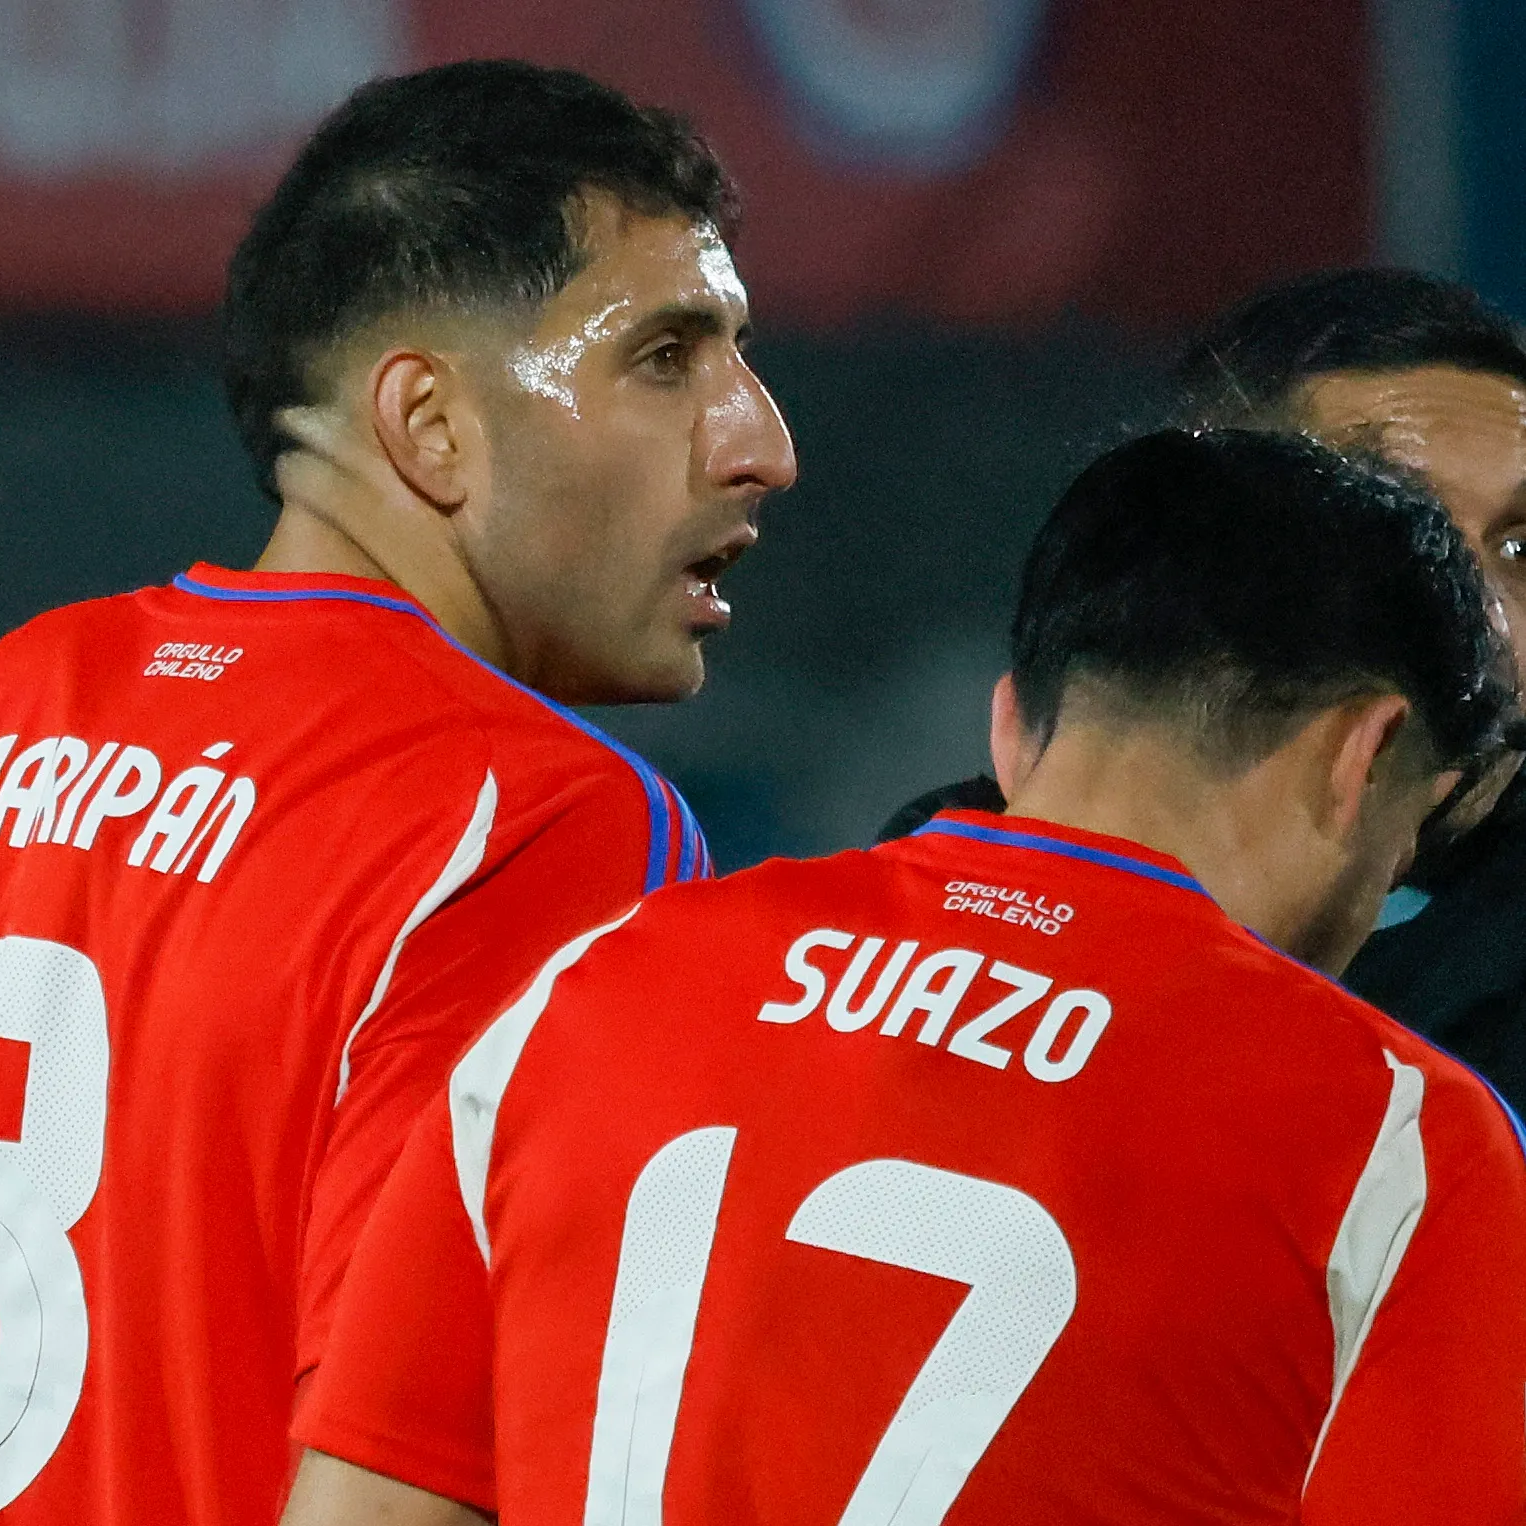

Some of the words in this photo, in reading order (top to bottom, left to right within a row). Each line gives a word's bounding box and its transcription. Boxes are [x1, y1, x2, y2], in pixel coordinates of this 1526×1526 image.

[143, 660, 225, 681] CHILENO
[154, 642, 244, 664] ORGULLO
[943, 895, 1061, 936] CHILENO
[944, 881, 1075, 923] ORGULLO
[757, 928, 1112, 1083] SUAZO
